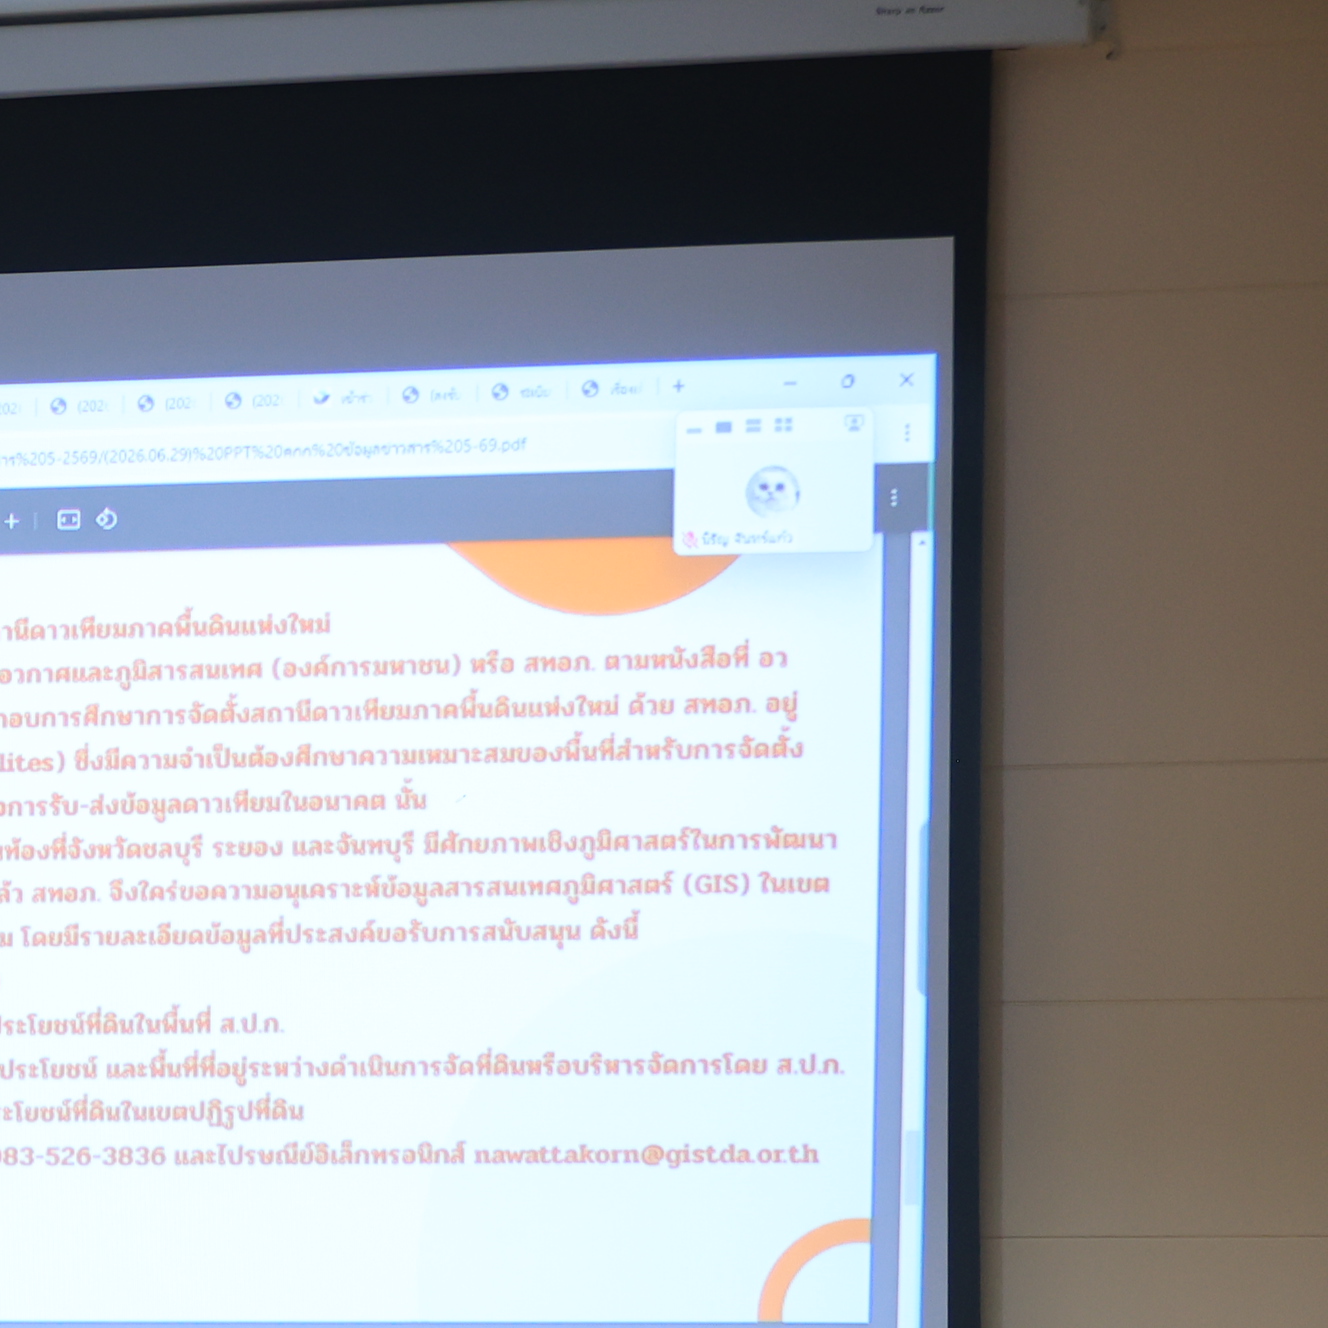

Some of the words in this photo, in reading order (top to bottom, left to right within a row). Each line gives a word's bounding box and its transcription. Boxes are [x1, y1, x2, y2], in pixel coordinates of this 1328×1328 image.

[273, 654, 462, 680] (องค์การมหาชน)
[471, 649, 515, 674] หรือ
[525, 655, 596, 673] สทอภ.
[606, 639, 750, 671] ตามหนังสือที่
[760, 651, 789, 668] อว
[629, 692, 676, 715] ด้วย
[685, 697, 757, 714] สทอภ.
[766, 690, 798, 722] อยู่
[396, 778, 427, 810] นั้น
[214, 841, 284, 858] ระยอง
[293, 830, 415, 864] และจันทบุรี
[33, 887, 101, 904] สทอภ.
[684, 872, 751, 897] (GIS)
[759, 871, 831, 894] ในเขต
[591, 909, 641, 940] ดังนี้
[221, 1013, 285, 1034] ส.ป.ก.
[778, 1053, 846, 1076] ส.ป.ก.
[475, 1143, 821, 1169] nawattakorn@gistda.or.th
